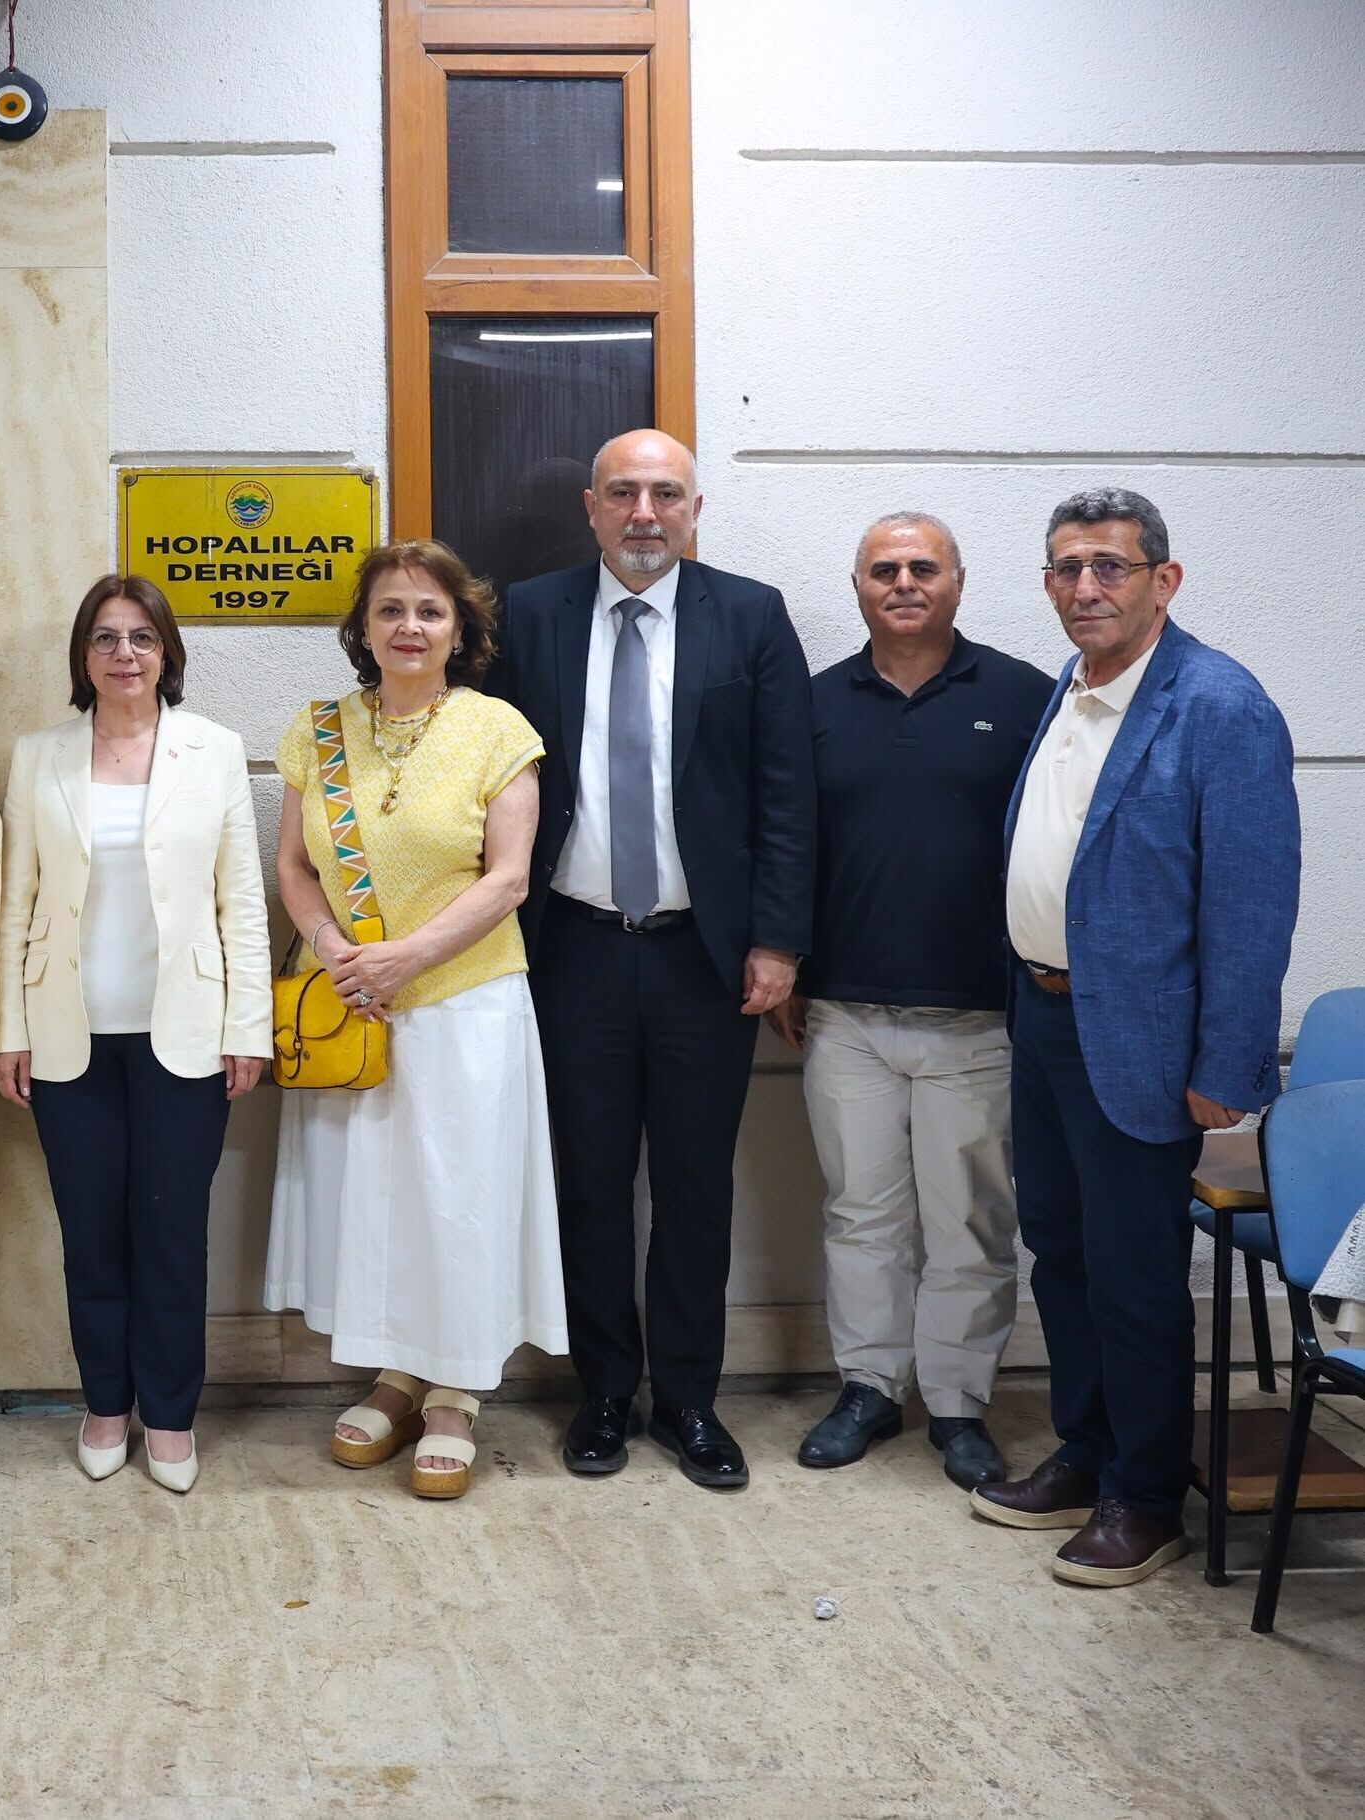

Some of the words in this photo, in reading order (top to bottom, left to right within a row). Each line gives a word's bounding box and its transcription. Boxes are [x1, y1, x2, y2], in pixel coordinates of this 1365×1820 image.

[146, 536, 354, 554] HOPALILAR
[167, 559, 333, 582] DERNEĞİ
[209, 591, 290, 608] 1997
